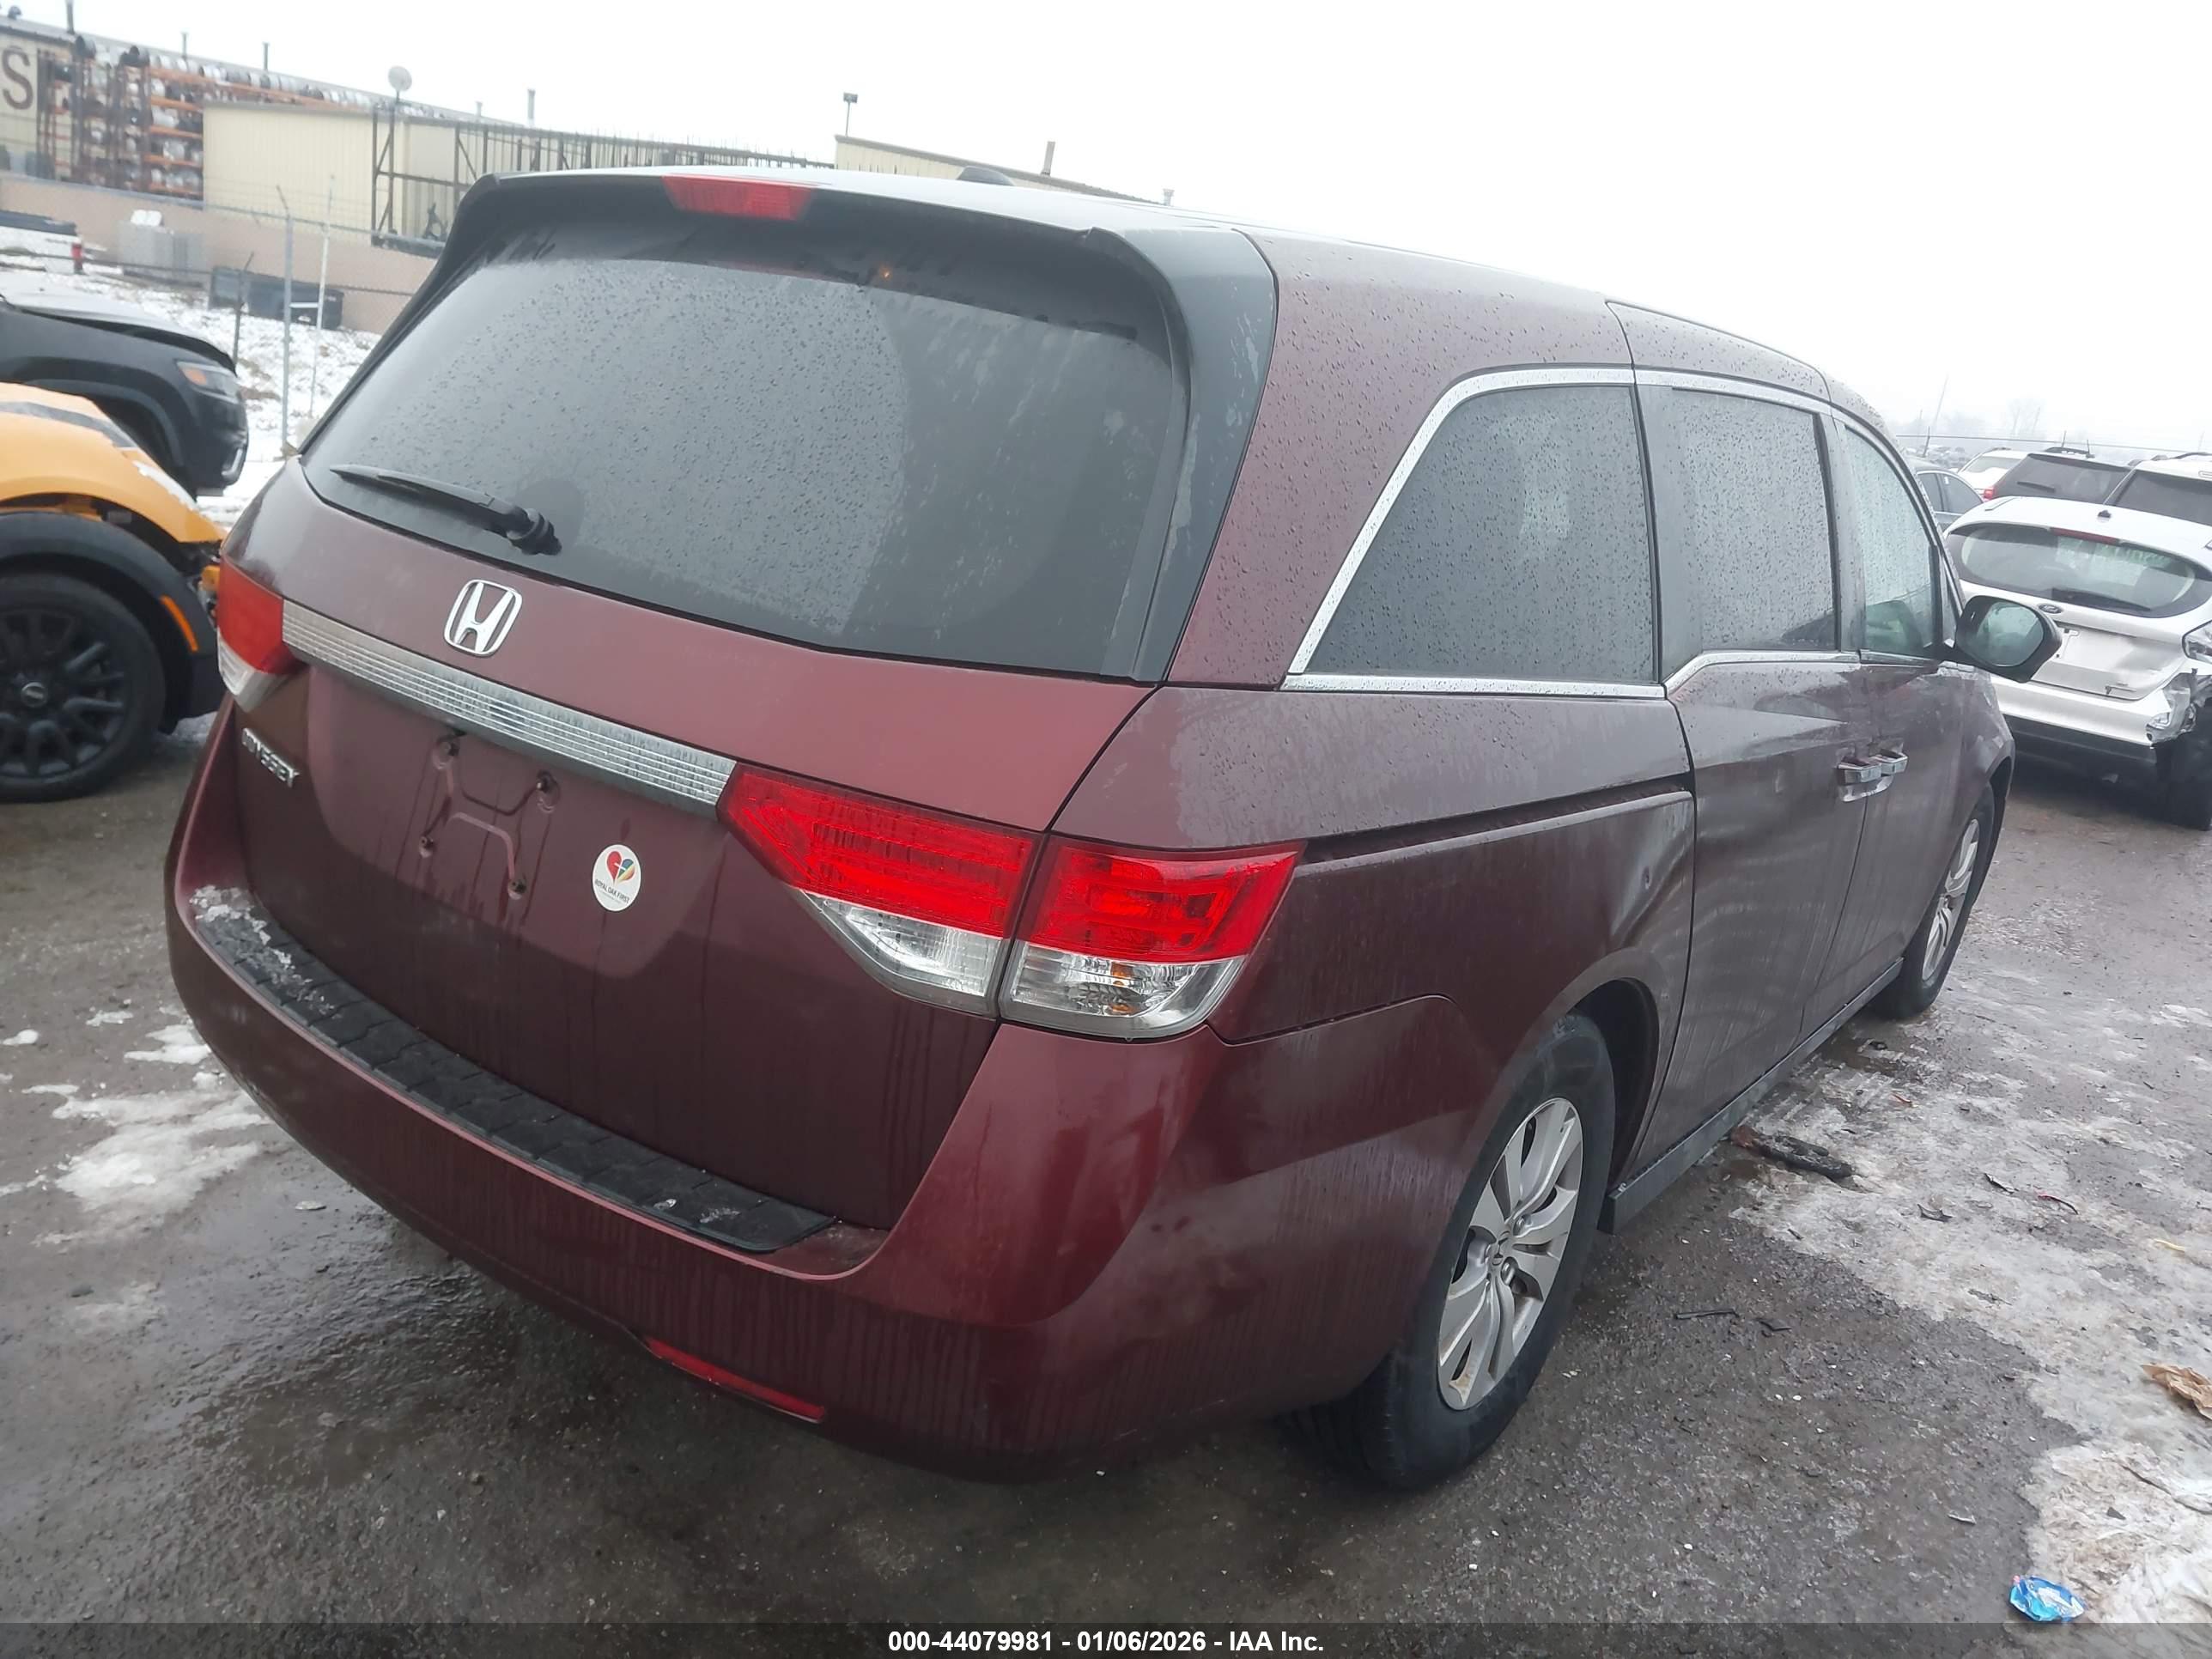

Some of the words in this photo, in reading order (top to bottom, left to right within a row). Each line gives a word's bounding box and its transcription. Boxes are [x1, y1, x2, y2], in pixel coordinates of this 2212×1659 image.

[3, 45, 33, 110] S
[594, 878, 607, 892] ROYAL
[607, 886, 617, 896] OAK
[617, 891, 630, 903] FIRST
